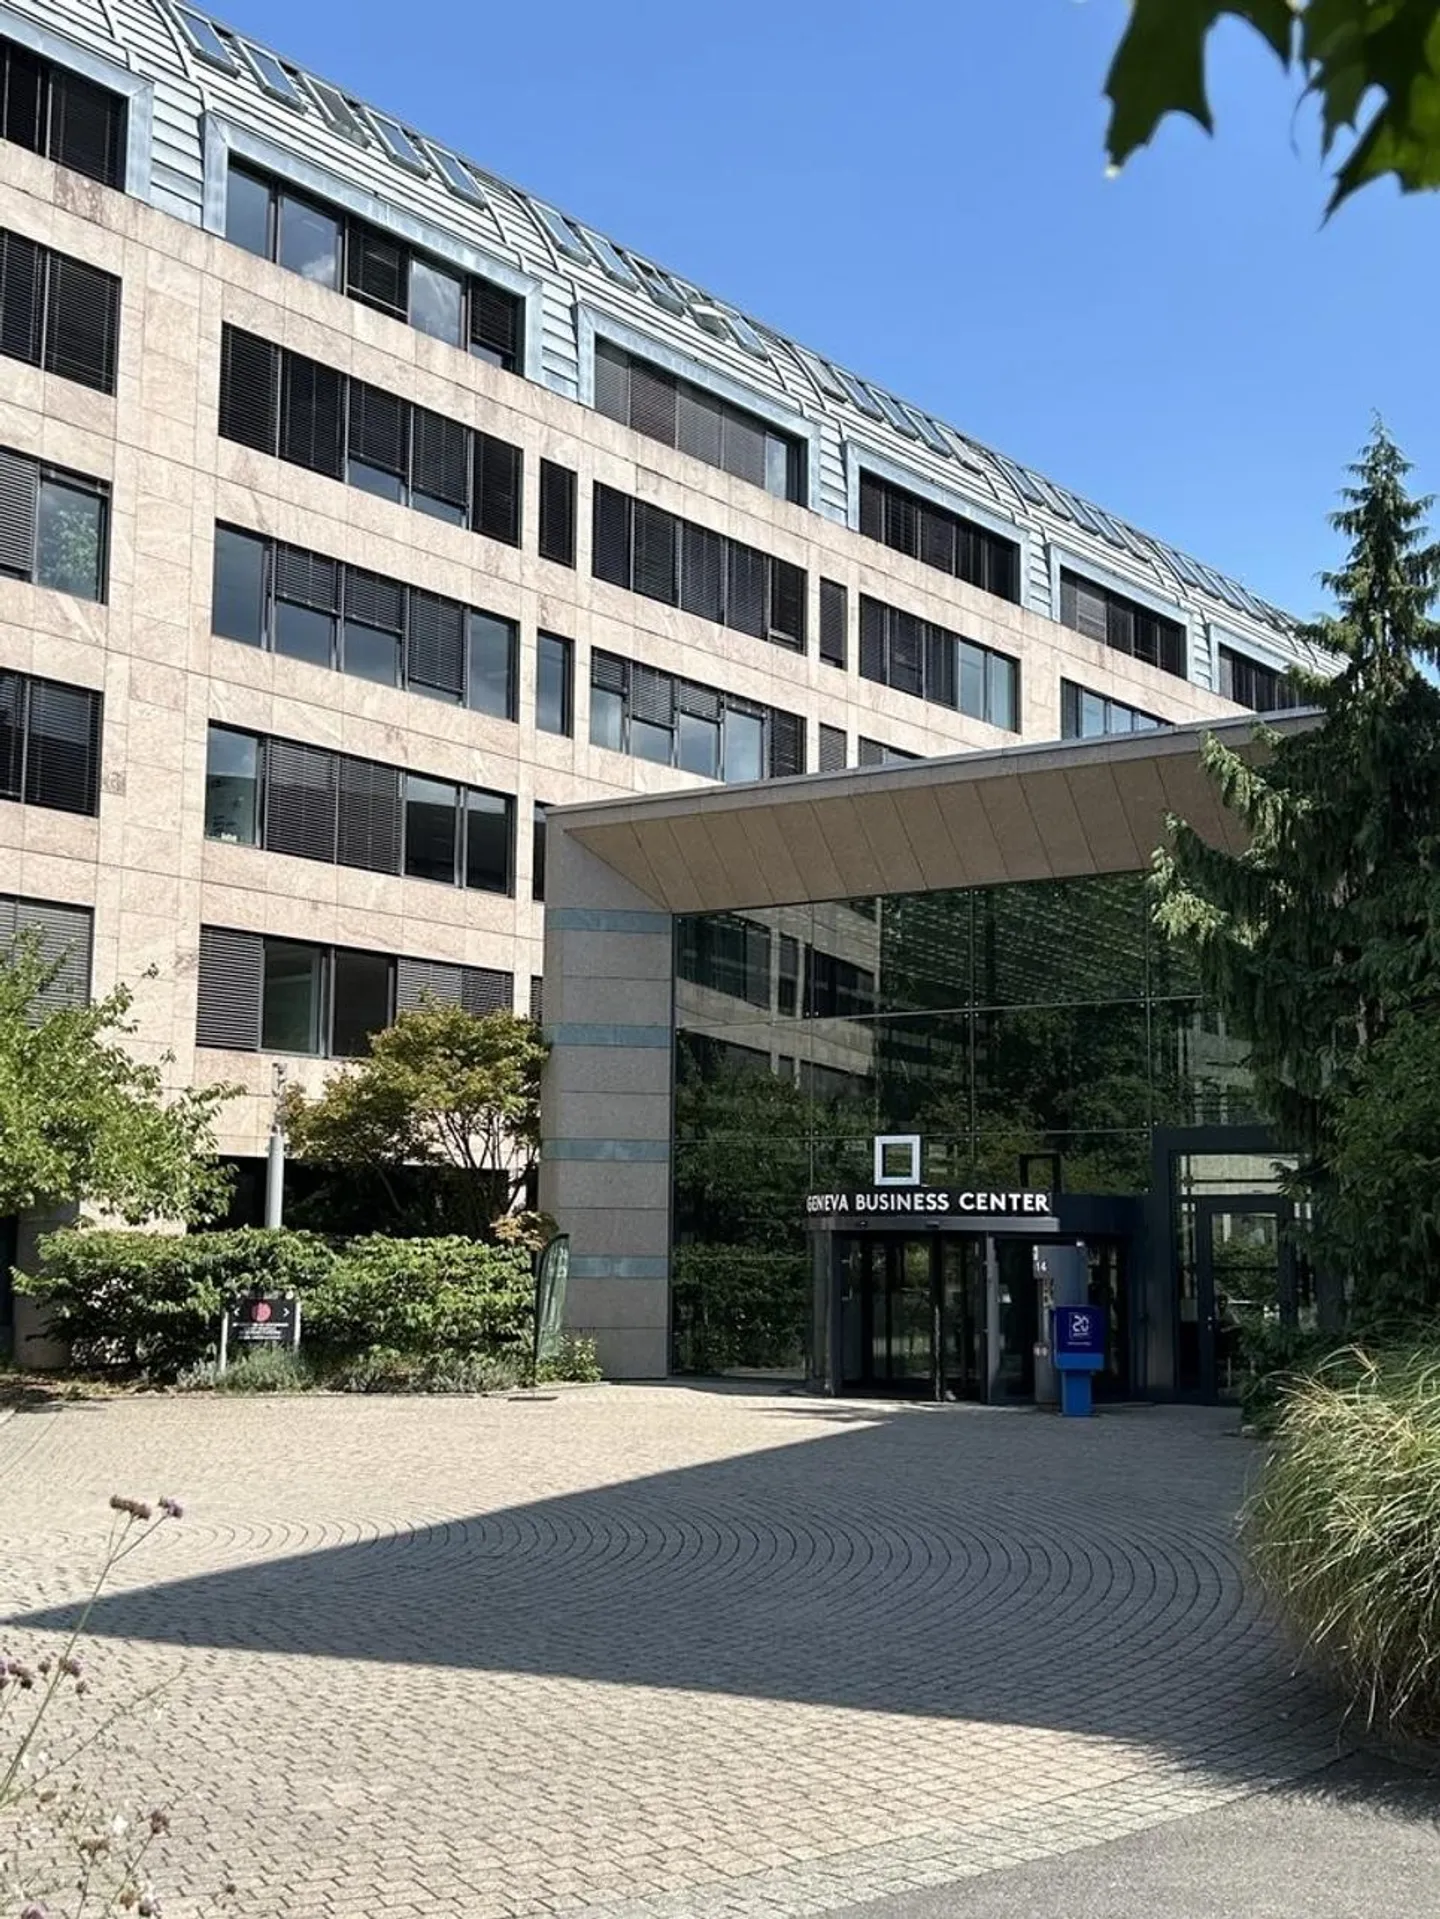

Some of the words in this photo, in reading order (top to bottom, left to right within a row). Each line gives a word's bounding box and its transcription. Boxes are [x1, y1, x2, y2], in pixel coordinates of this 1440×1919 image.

[806, 1193, 849, 1212] GENEVA
[855, 1193, 949, 1211] BUSINESS
[958, 1192, 1050, 1211] CENTER
